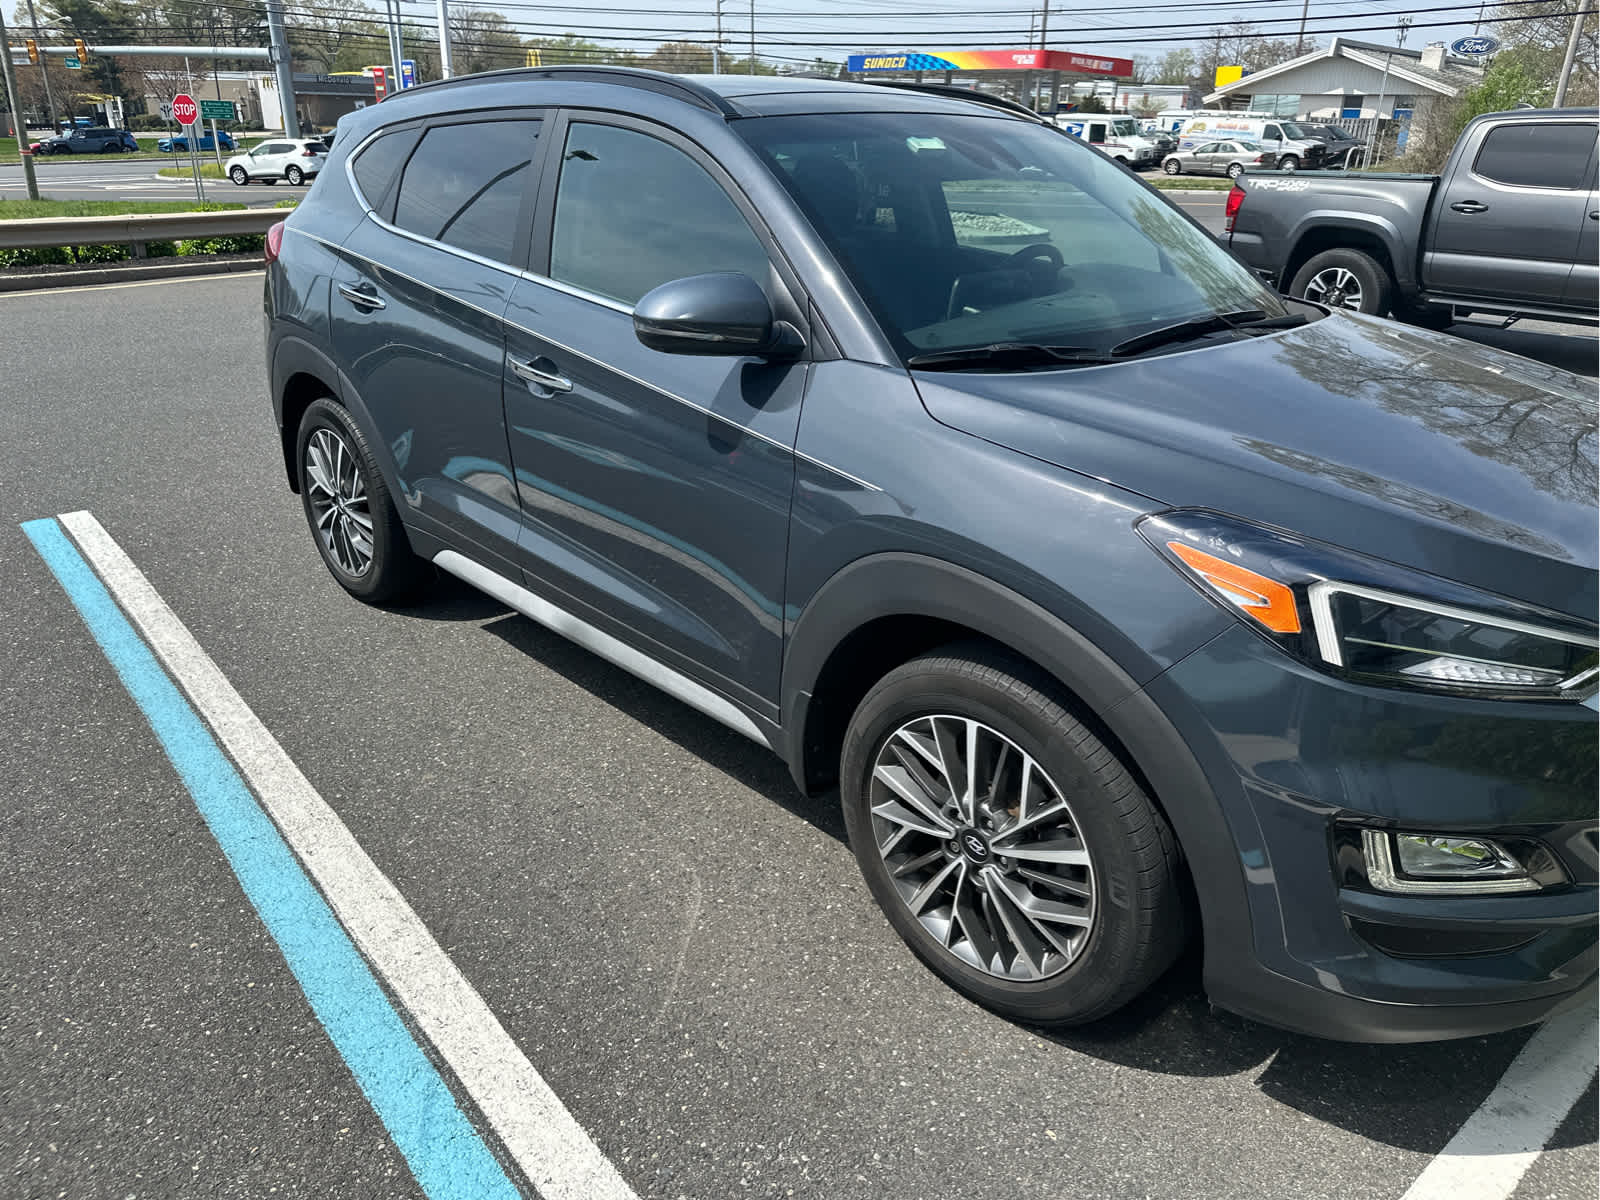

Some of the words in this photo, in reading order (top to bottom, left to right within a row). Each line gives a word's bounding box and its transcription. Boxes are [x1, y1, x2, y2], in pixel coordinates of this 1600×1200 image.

[1460, 39, 1489, 52] Ford
[863, 57, 907, 69] SUNOCO
[174, 103, 196, 116] STOP
